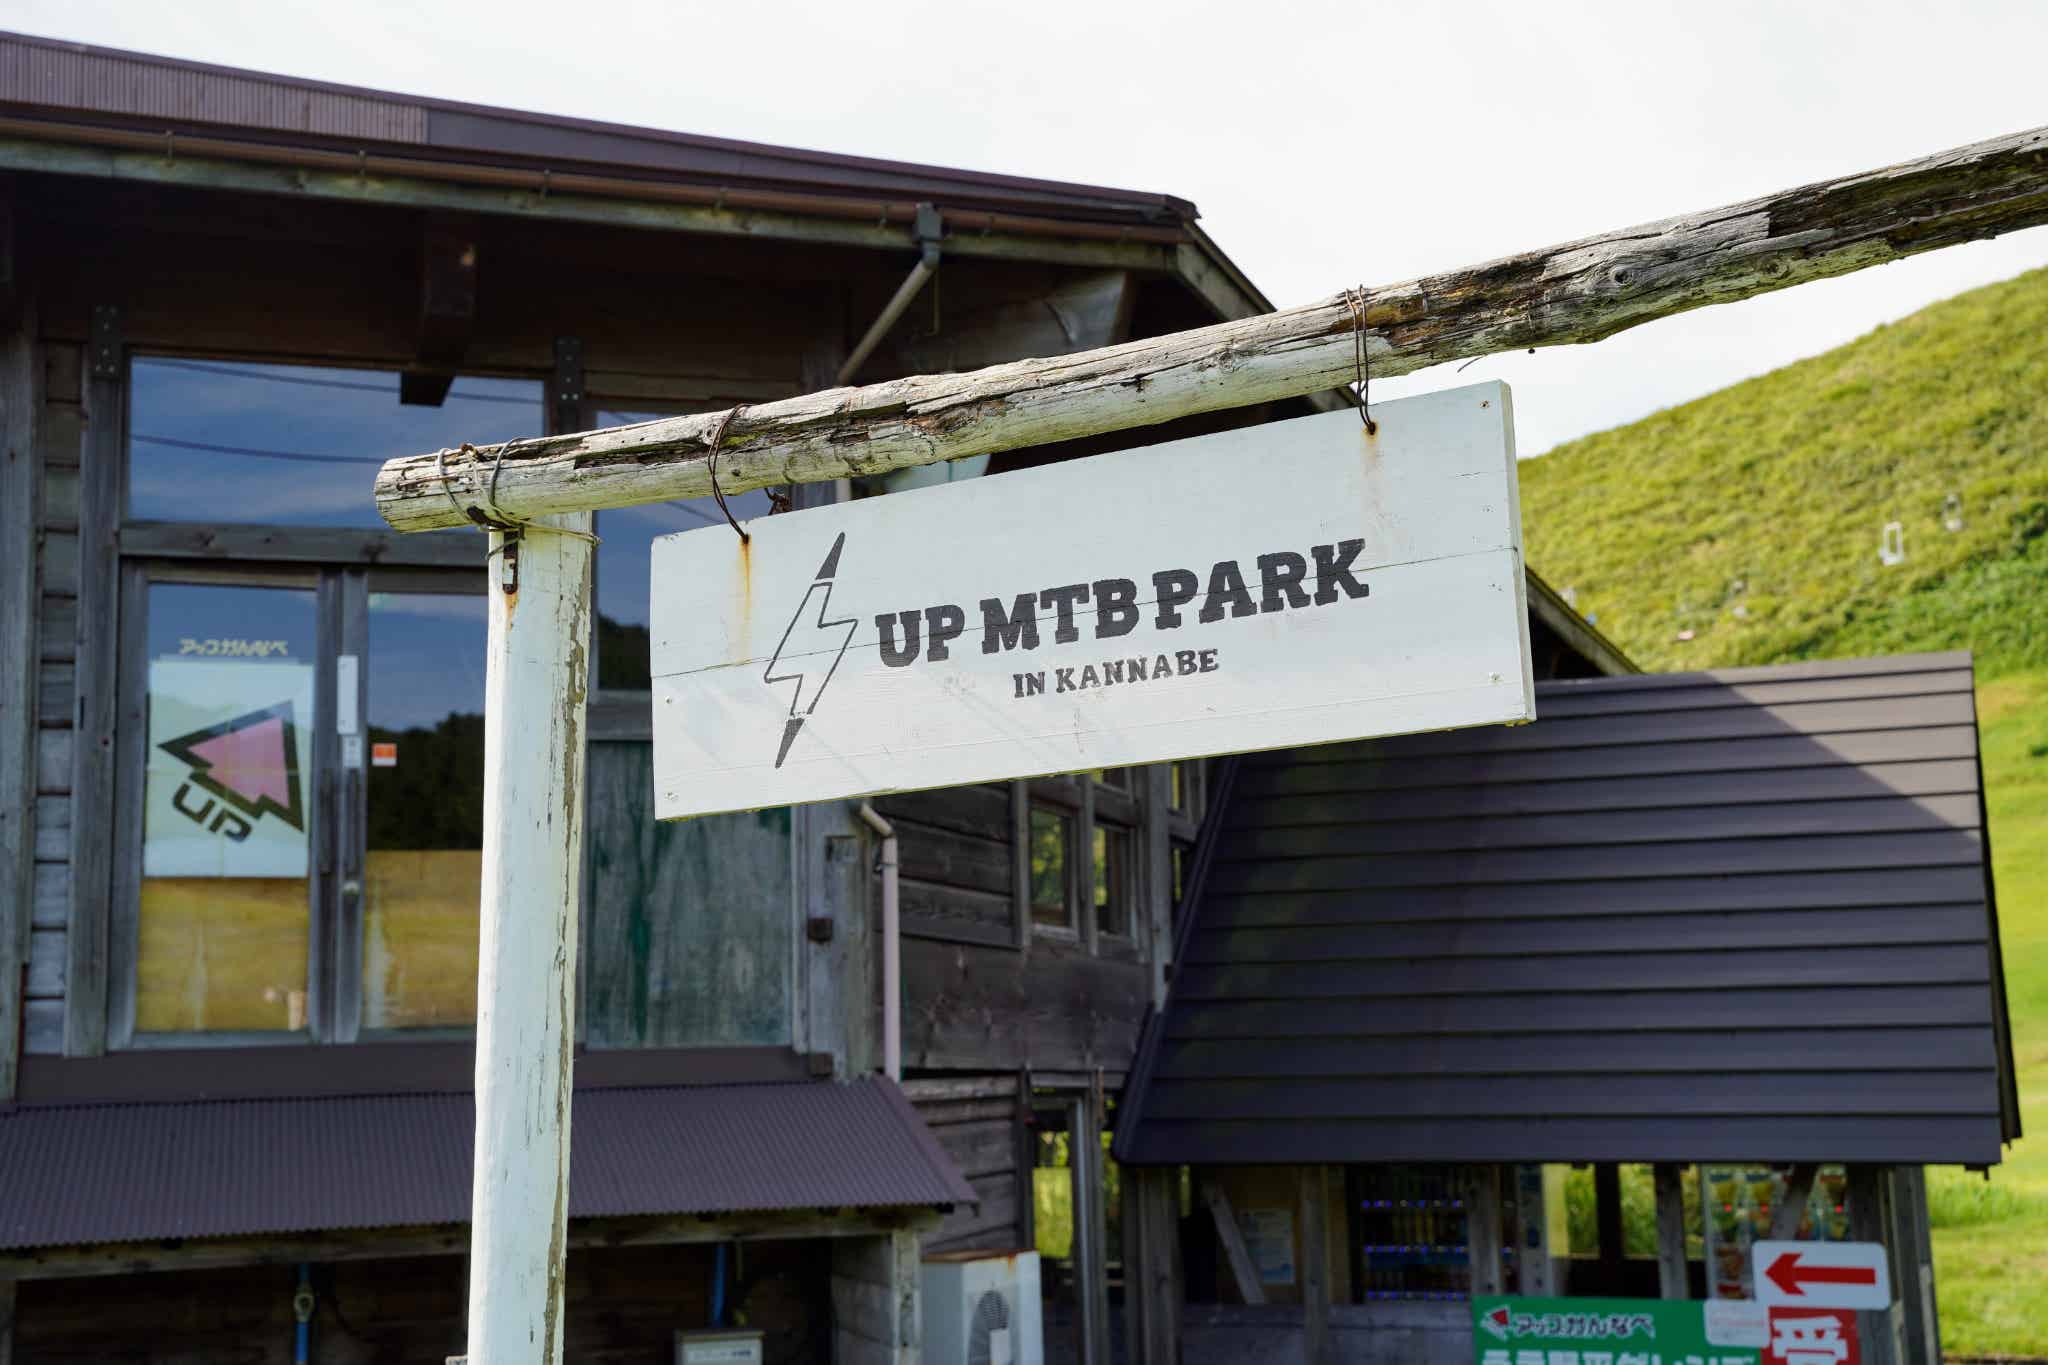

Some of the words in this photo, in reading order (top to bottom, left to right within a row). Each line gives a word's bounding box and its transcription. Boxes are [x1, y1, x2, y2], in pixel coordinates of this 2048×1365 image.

[874, 603, 966, 668] UP
[979, 577, 1140, 655] MTB
[1151, 537, 1371, 631] PARK
[1012, 671, 1046, 699] IN
[1055, 647, 1220, 695] KANNABE
